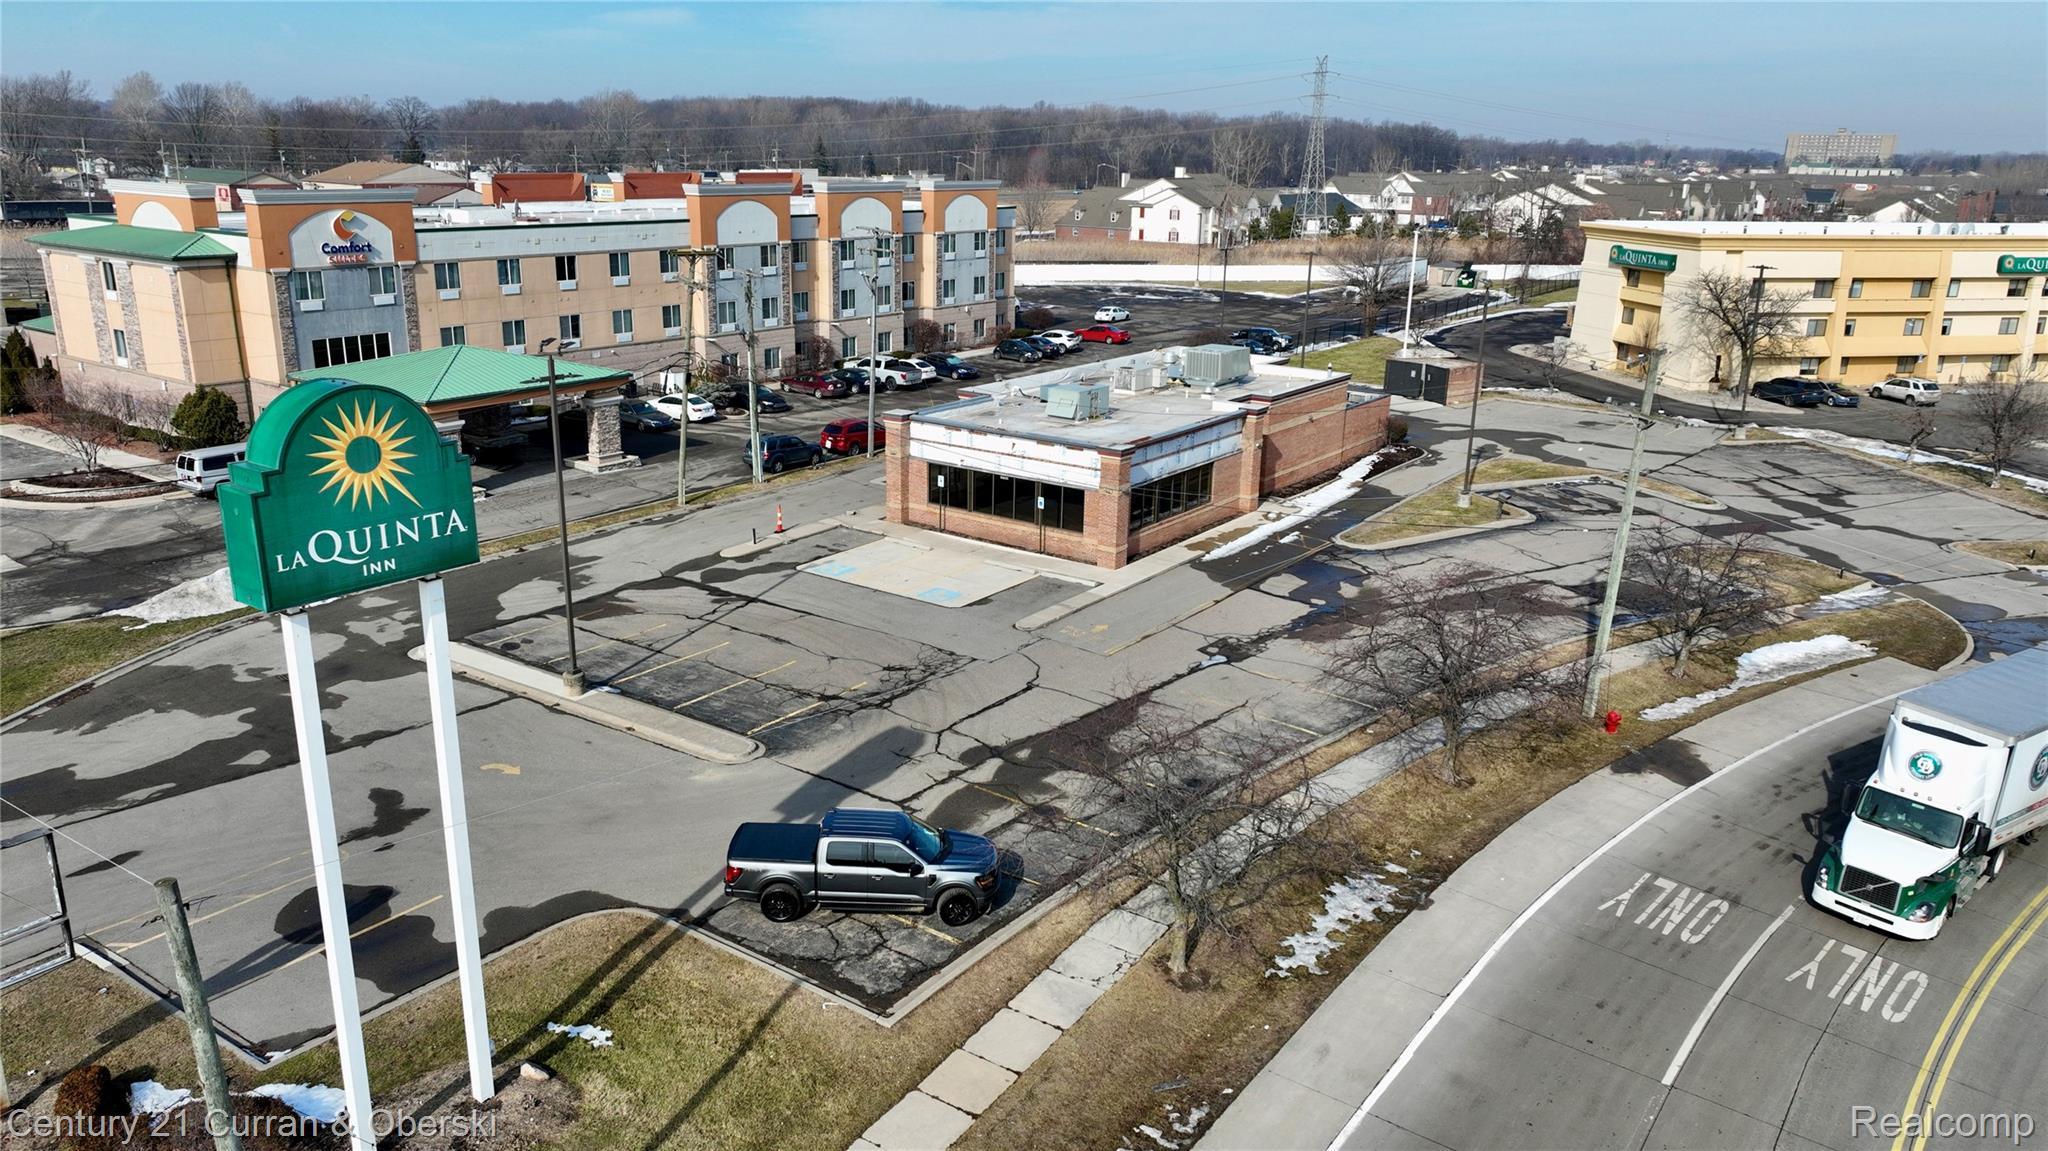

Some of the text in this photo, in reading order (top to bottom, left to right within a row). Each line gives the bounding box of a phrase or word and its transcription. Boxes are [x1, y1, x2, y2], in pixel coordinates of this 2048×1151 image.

[321, 241, 372, 255] Comfort
[1625, 250, 1657, 265] QUINTA
[275, 509, 467, 573] LA QUINTA
[363, 558, 396, 577] INN
[1597, 872, 1730, 944] ONLY
[1784, 939, 1929, 1023] ONLY
